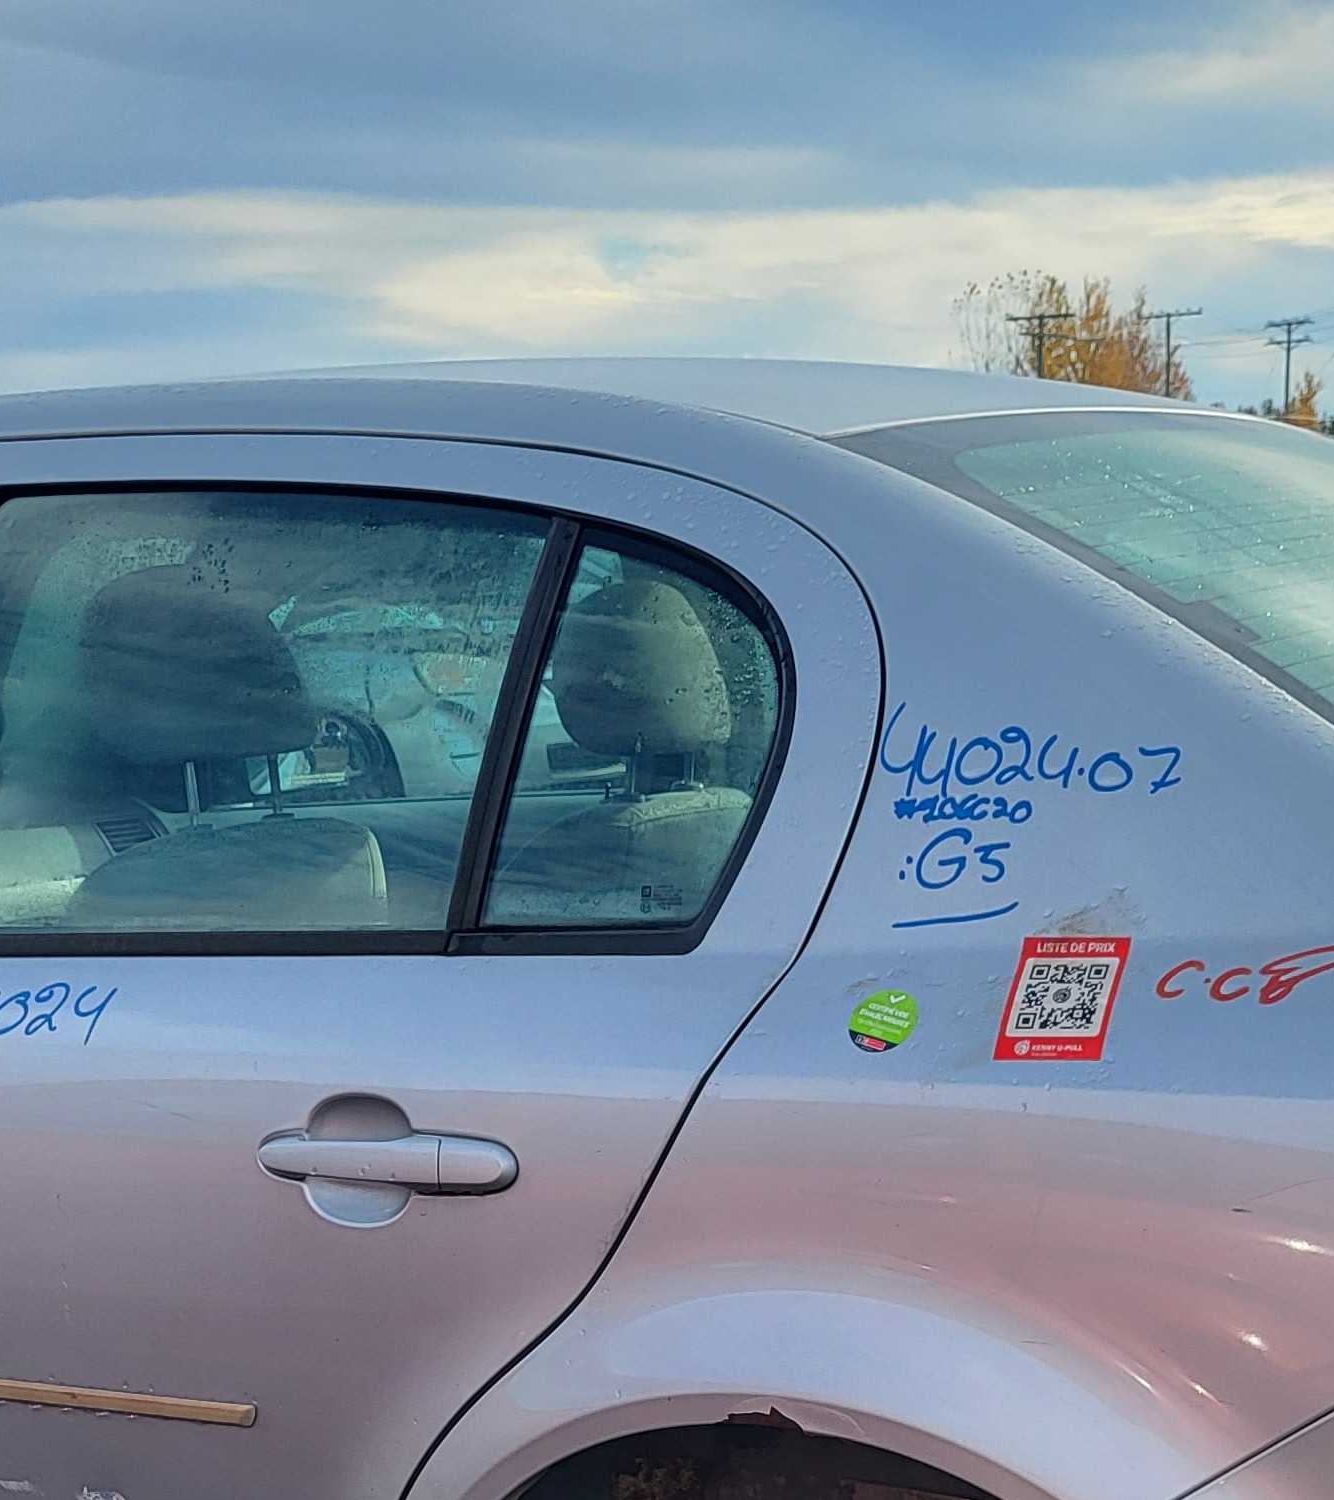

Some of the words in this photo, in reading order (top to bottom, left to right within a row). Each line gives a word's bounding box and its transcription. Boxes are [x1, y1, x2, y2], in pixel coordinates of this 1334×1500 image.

[1036, 942, 1068, 953] LISTE
[1070, 942, 1087, 953] DE
[1088, 942, 1116, 953] PRIX
